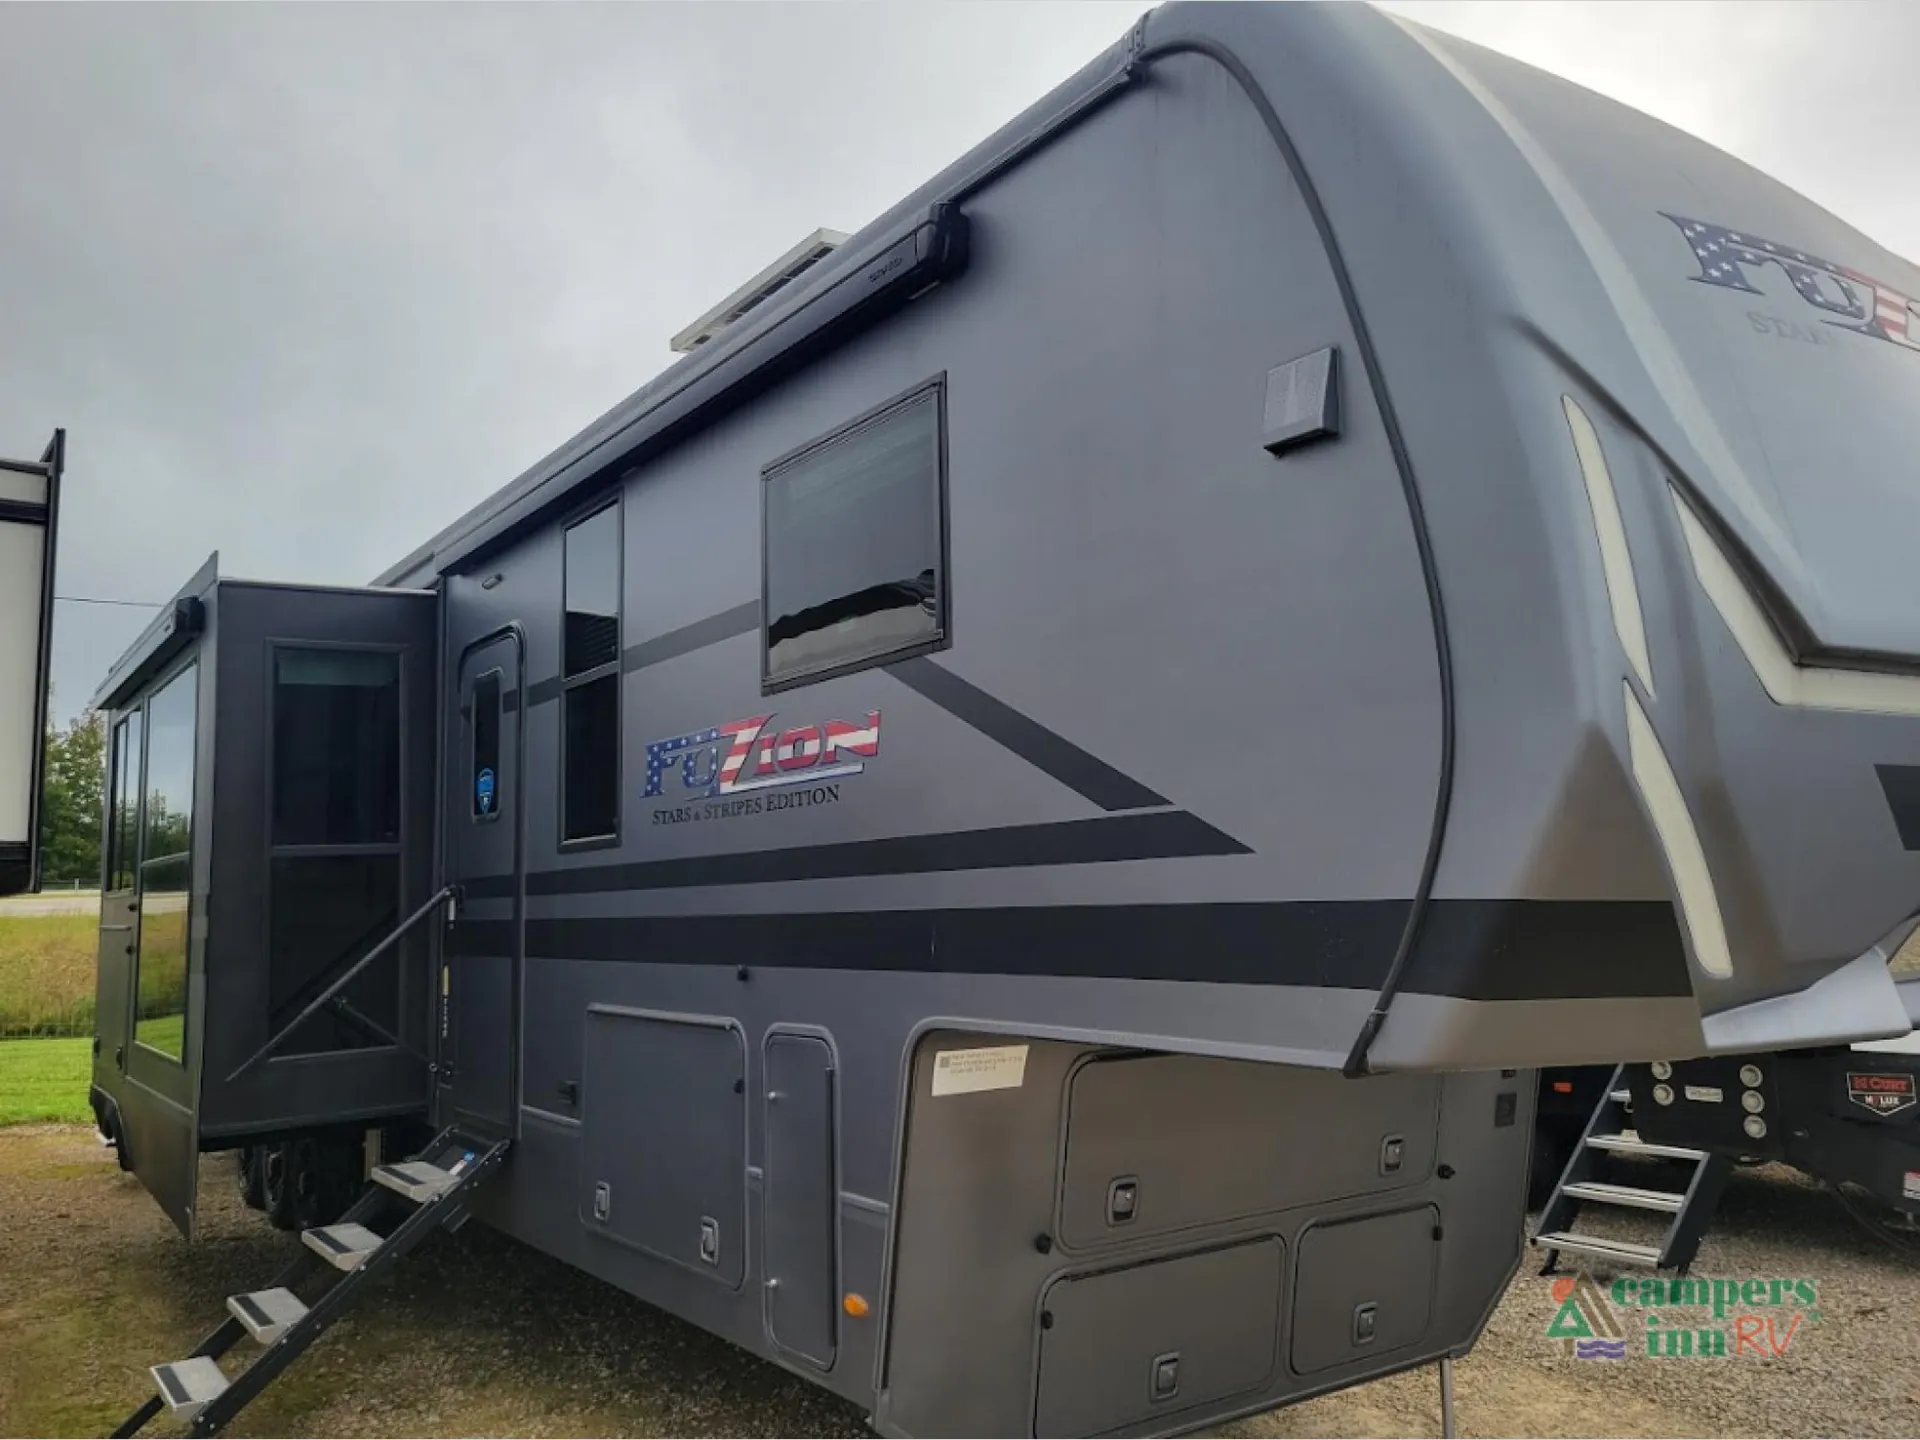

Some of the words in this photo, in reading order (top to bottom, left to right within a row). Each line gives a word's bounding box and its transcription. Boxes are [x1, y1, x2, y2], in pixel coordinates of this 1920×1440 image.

[1656, 210, 1920, 352] FUZ
[652, 806, 691, 825] STARS
[703, 797, 763, 820] STRIPES
[766, 784, 840, 812] EDITION
